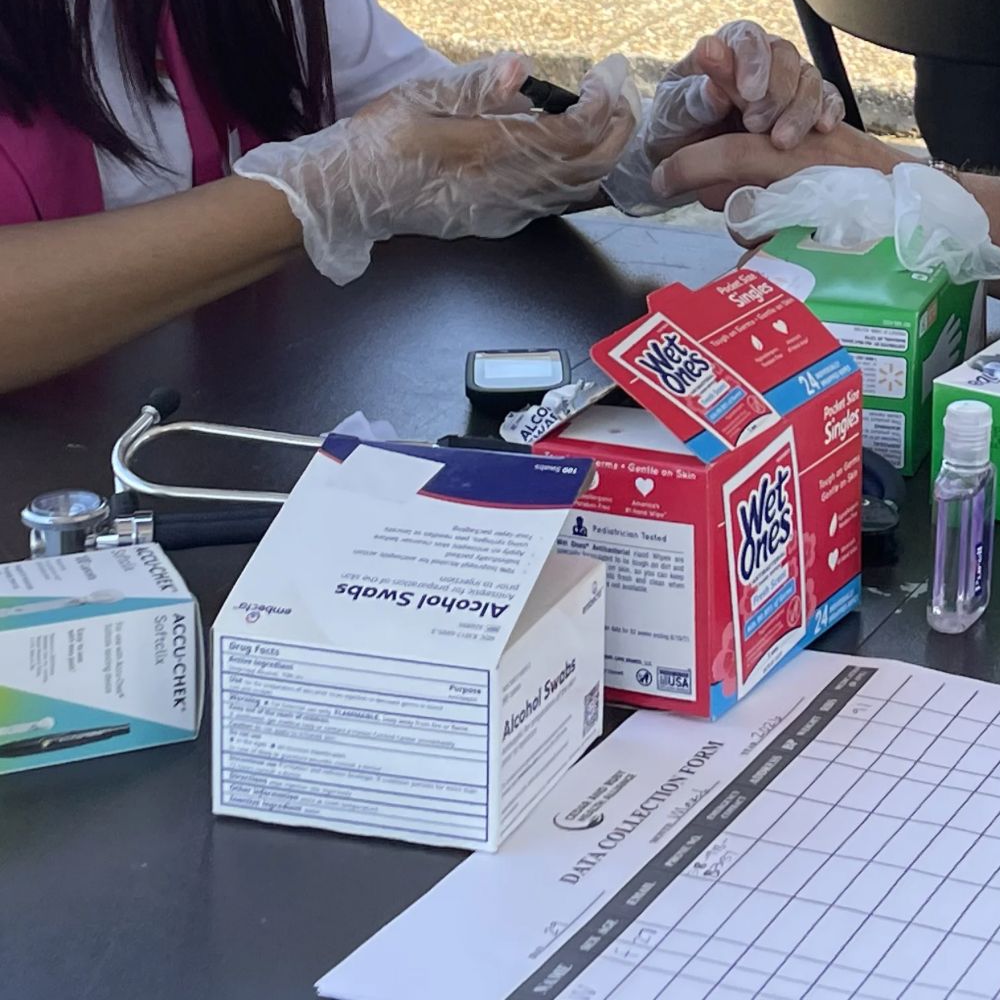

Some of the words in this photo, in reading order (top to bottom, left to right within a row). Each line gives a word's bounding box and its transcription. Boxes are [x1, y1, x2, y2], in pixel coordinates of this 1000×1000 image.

[717, 280, 740, 296] Pocket
[738, 273, 758, 287] Size
[729, 282, 774, 308] Singles
[641, 334, 687, 377] Wet
[663, 355, 710, 395] Ones
[799, 373, 820, 397] 24
[823, 396, 846, 421] Pocket
[845, 388, 860, 408] Size
[824, 407, 860, 444] Singles
[595, 459, 617, 469] erms
[627, 462, 658, 475] Gentle
[661, 468, 672, 477] on
[675, 469, 696, 480] Skin
[740, 468, 790, 537] Wet
[592, 524, 638, 539] Pediatrician
[641, 531, 666, 543] Tested
[740, 507, 791, 582] Ones
[236, 600, 294, 616] embecta
[335, 582, 414, 607] Swabs
[416, 594, 510, 619] Alcohol
[815, 604, 829, 634] 24
[154, 615, 168, 666] Softclix
[228, 641, 251, 655] Drug
[254, 645, 279, 657] Facts
[172, 612, 187, 709] ACCU-CHEK
[449, 683, 481, 696] Purpose
[668, 676, 689, 688] USA
[502, 687, 542, 741] Alcohol
[543, 658, 577, 701] Swabs
[559, 852, 607, 885] DATA
[598, 775, 688, 850] COLLECTION
[679, 740, 725, 775] FORM
